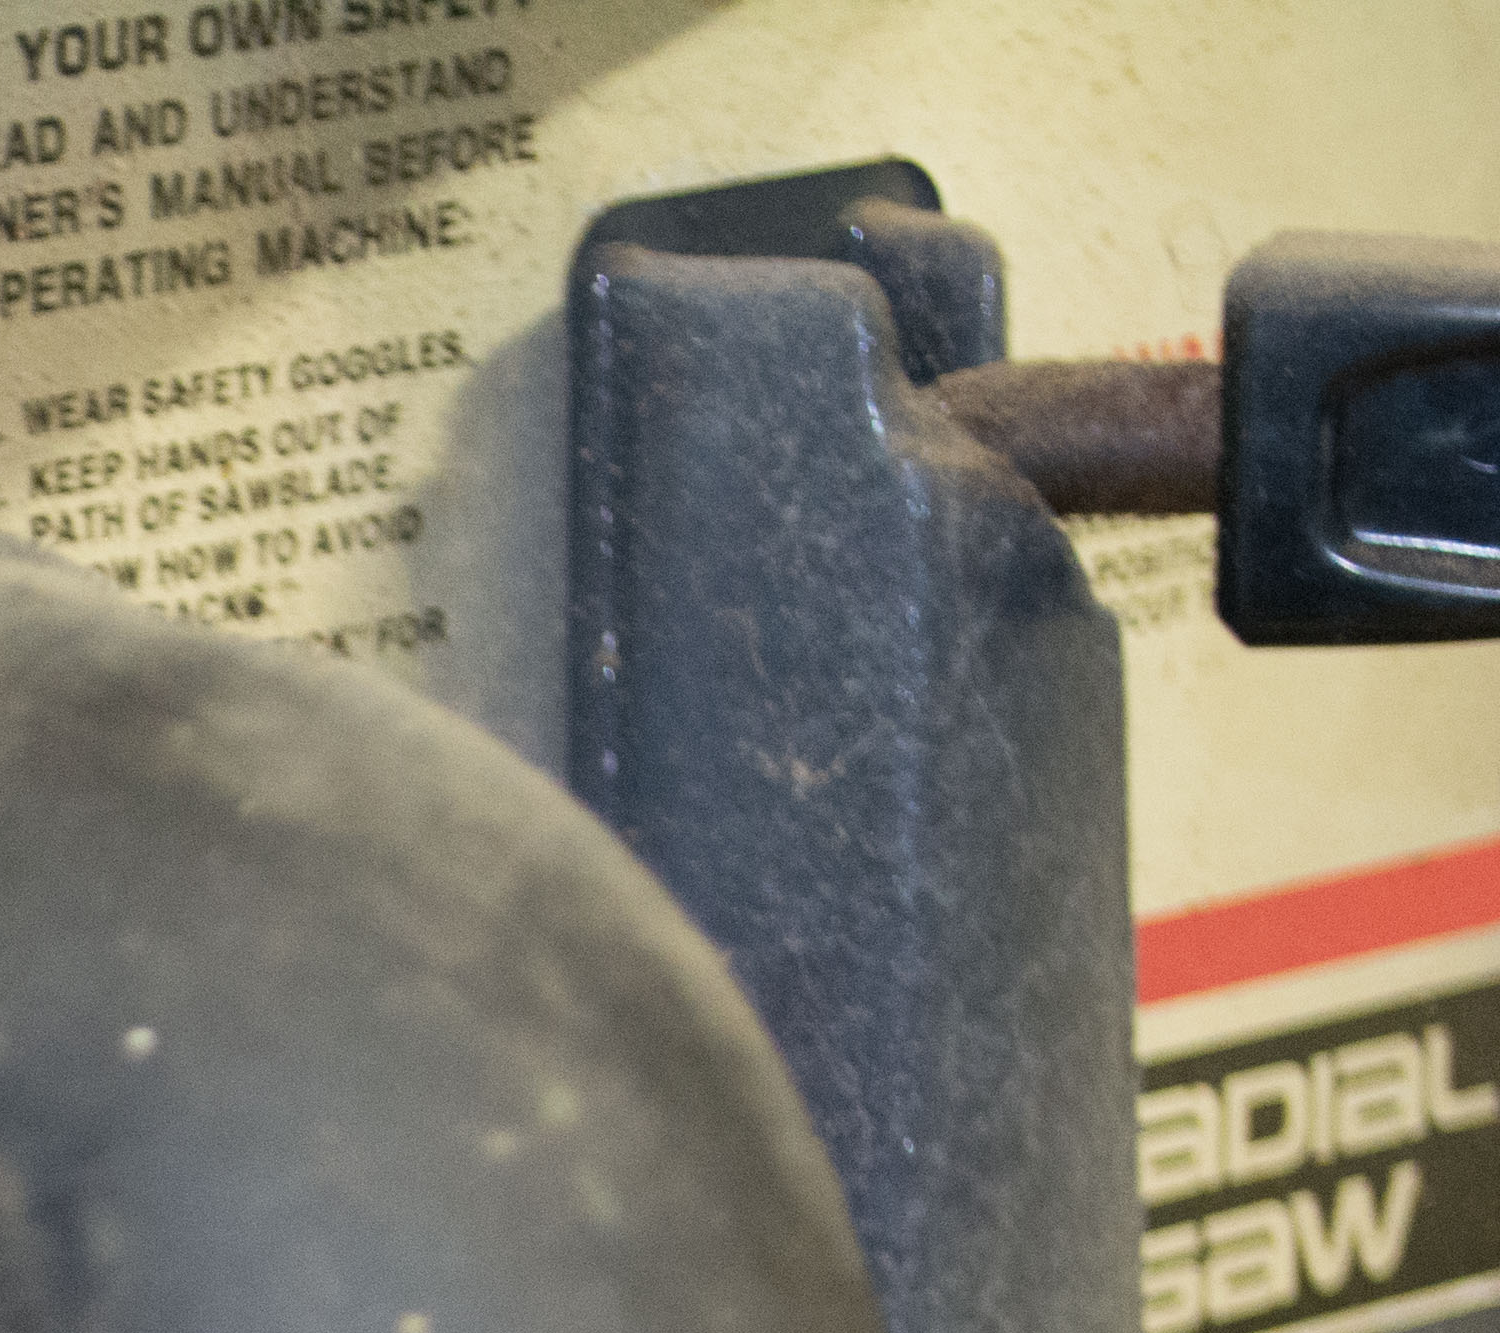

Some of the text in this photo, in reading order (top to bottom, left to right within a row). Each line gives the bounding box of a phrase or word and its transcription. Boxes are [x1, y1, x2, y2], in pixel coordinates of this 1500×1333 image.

[14, 13, 171, 82] YOUR
[187, 0, 324, 58] OWN
[92, 98, 190, 157] AND
[210, 48, 514, 138] UNDERSTAND
[150, 148, 343, 222] MANUAL
[360, 113, 540, 188] BEFORE
[21, 382, 133, 437] WEAR
[140, 362, 276, 420] SAFETY
[28, 449, 127, 499] KEEP
[134, 426, 262, 481] HANDS
[270, 409, 344, 458] OUT
[355, 401, 404, 445] OF
[30, 501, 127, 549] PATH
[137, 488, 188, 534] OF
[155, 541, 244, 588] HOW
[252, 526, 300, 568] TO
[310, 502, 427, 557] AVOID
